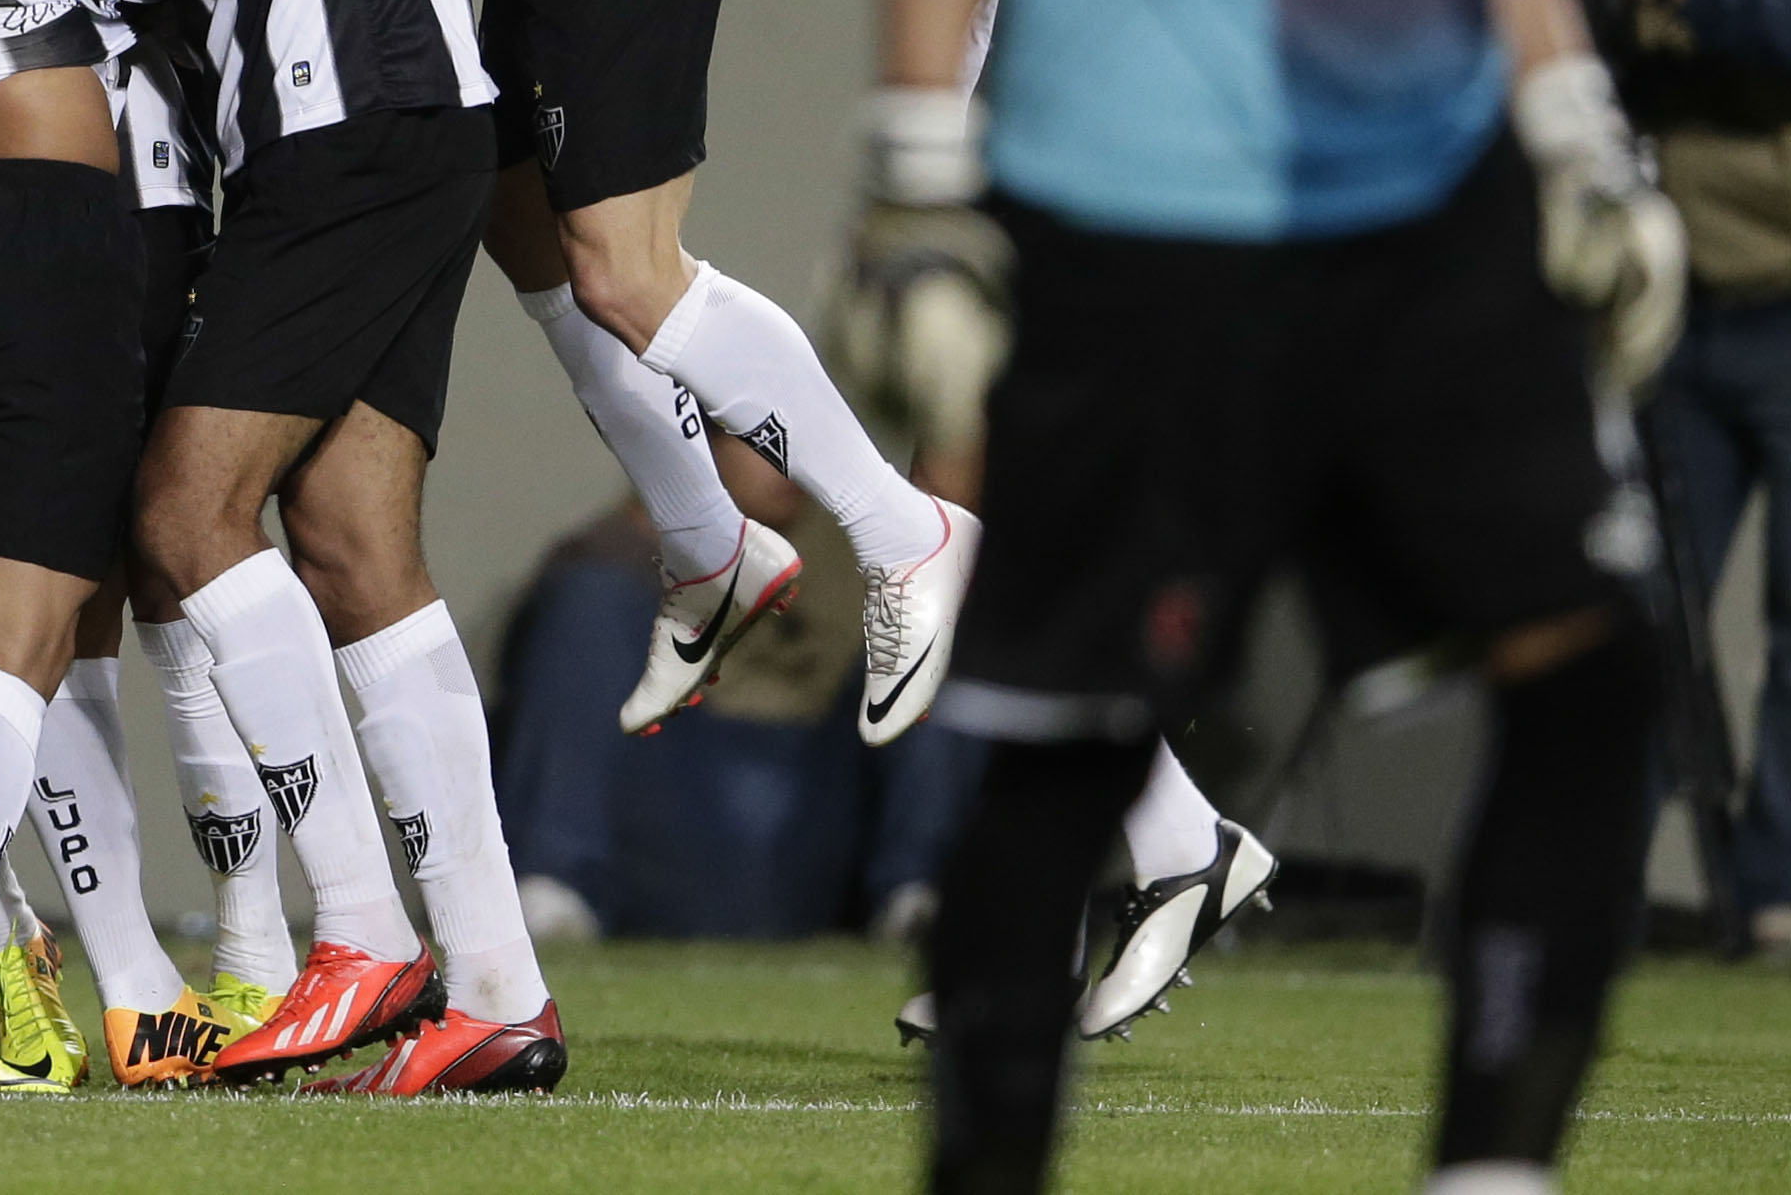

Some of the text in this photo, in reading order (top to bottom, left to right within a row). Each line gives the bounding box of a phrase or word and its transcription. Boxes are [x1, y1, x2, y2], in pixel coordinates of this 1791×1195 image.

[673, 379, 700, 440] PO
[266, 768, 303, 791] AM
[33, 776, 101, 895] LUPO
[207, 819, 250, 836] AM
[127, 1011, 231, 1068] NIKE
